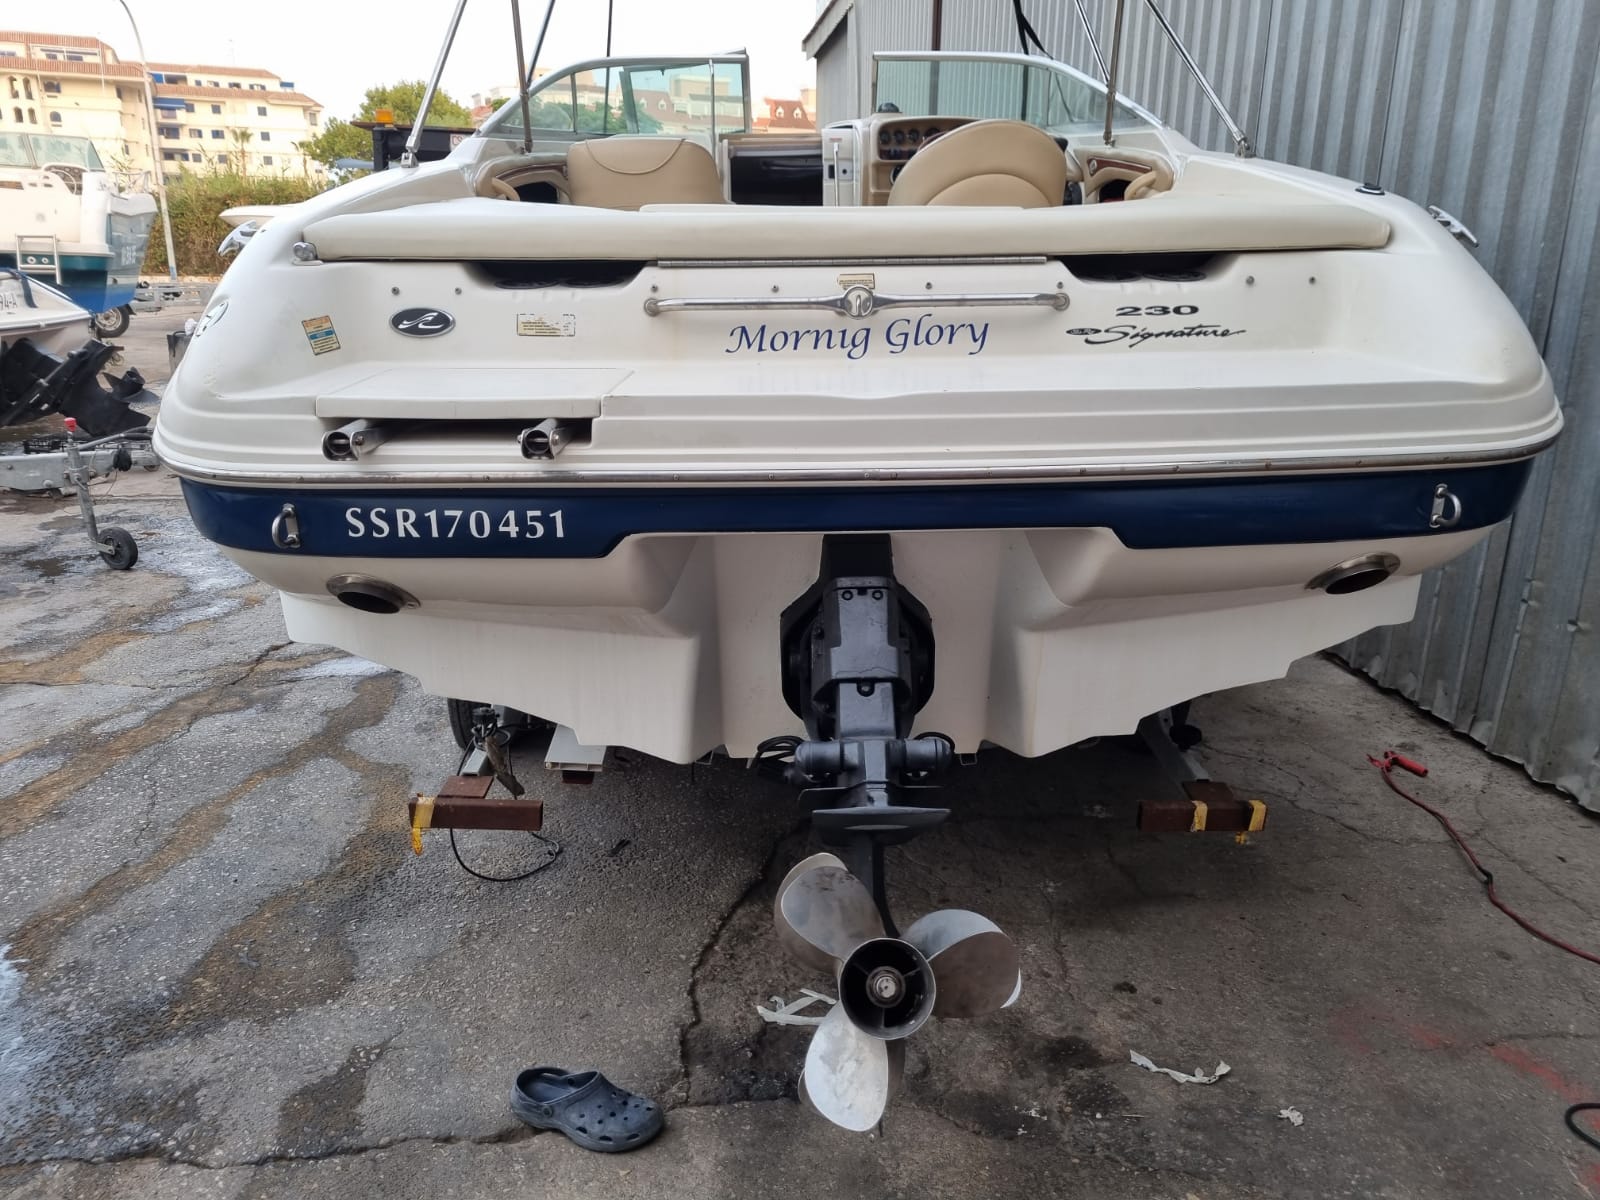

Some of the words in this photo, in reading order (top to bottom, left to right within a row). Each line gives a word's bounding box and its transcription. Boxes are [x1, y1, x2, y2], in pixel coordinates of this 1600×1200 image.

[1115, 305, 1199, 317] 230
[725, 324, 871, 360] Mornig
[885, 313, 989, 356] Glory
[1084, 324, 1247, 348] Signature
[345, 507, 565, 539] SSR170451
